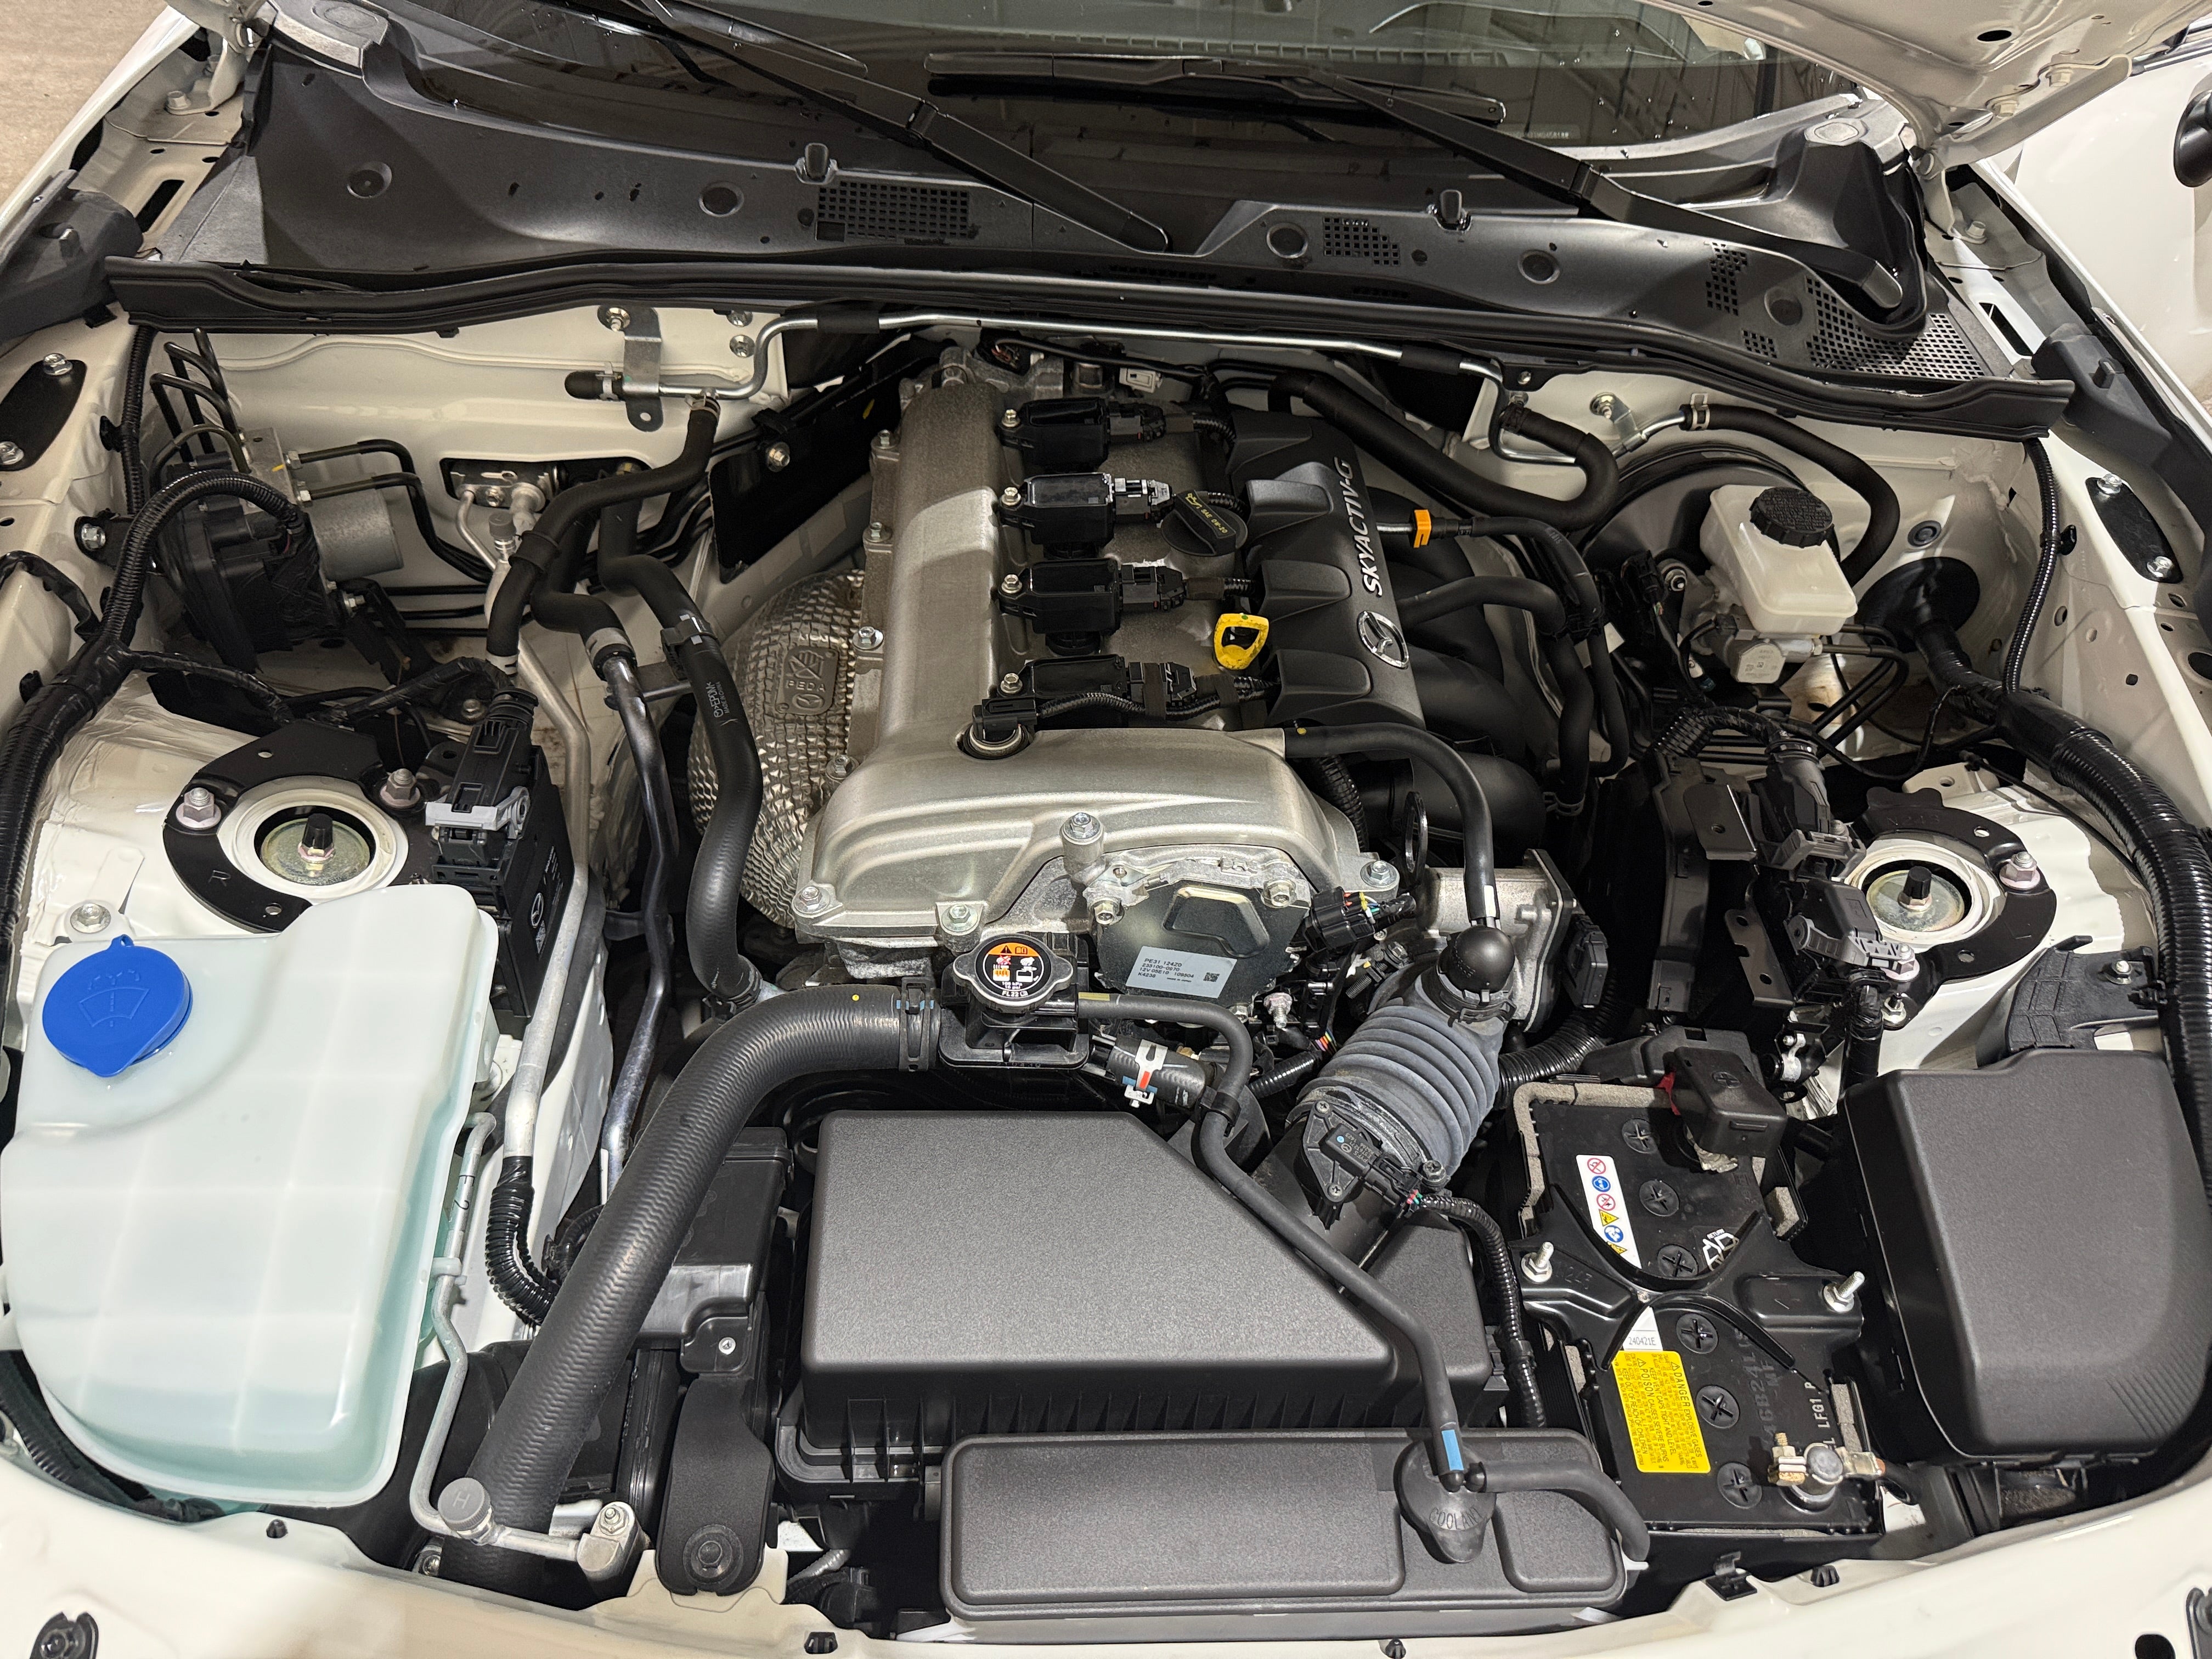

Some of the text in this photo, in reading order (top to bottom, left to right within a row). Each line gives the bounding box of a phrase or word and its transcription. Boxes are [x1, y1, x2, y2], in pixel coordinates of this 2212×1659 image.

[1201, 509, 1228, 533] SAE 0W-20
[1334, 457, 1383, 597] SKYACTIV-G
[786, 680, 825, 692] PEDA
[1629, 1337, 1656, 1346] 240421E
[1621, 1368, 1630, 1380] KEEP
[1630, 1401, 1640, 1418] REACH
[1637, 1427, 1649, 1453] CHILDREN
[1639, 1368, 1669, 1462] POISON CAUSES SEVERE BURNS
[1649, 1367, 1677, 1455] KEEP VENT CAPS TIGHT AND LEVEL
[1673, 1372, 1690, 1407] DANGER
[1683, 1408, 1697, 1437] EXPLOSIVE
[1691, 1439, 1702, 1457] GASES
[453, 1491, 470, 1509] H
[1429, 1505, 1483, 1530] COOLANT
